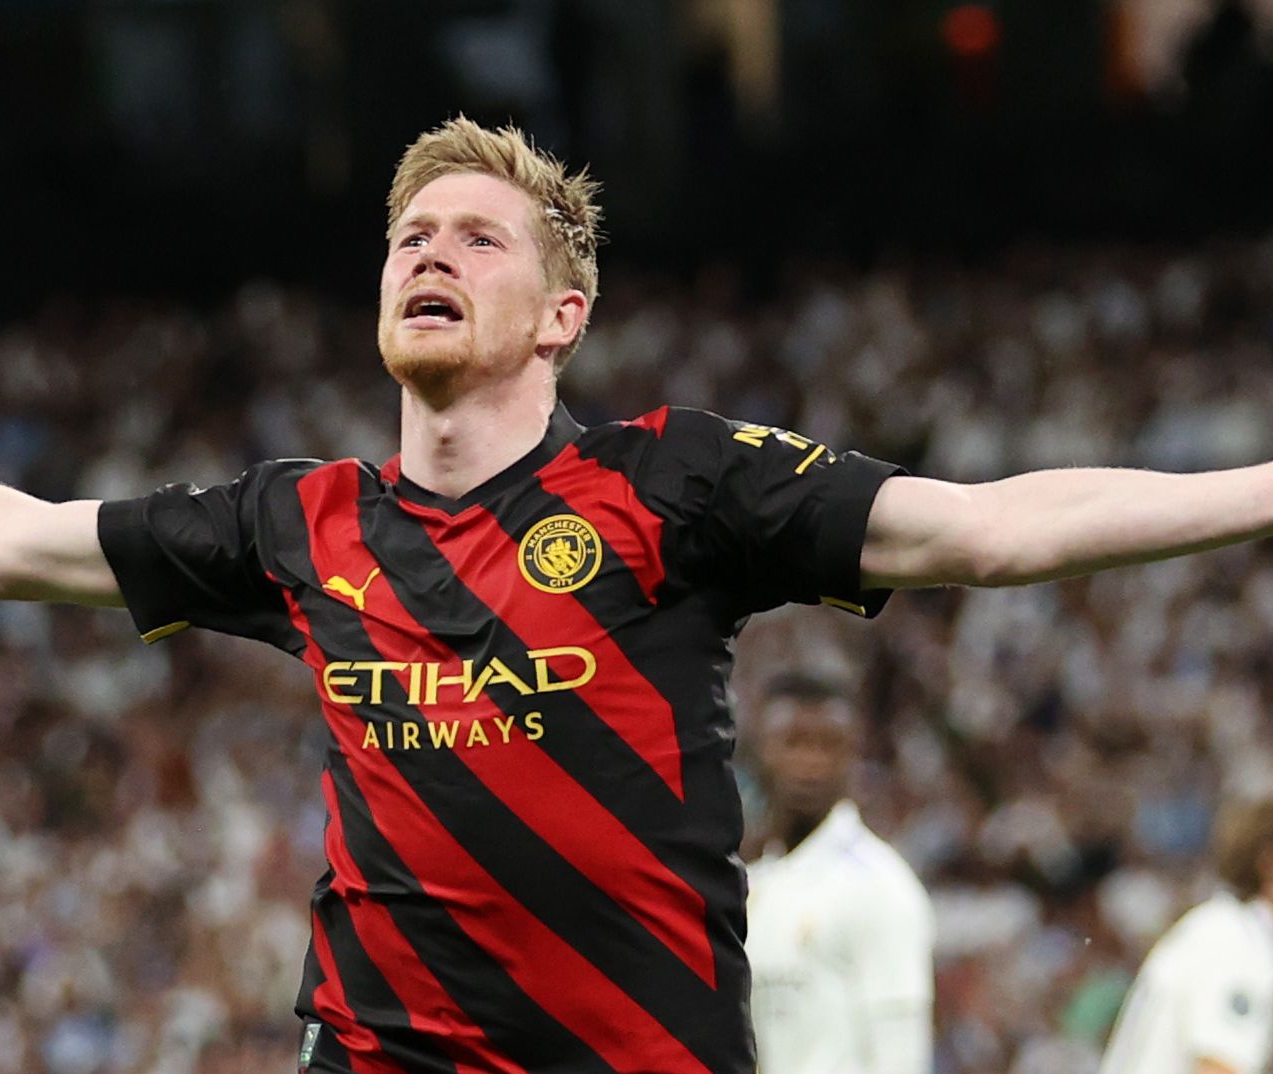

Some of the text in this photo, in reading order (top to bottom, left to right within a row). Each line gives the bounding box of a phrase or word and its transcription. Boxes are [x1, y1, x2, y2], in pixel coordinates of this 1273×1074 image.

[528, 520, 592, 548] MANCHESTER
[549, 577, 574, 587] CITY
[323, 646, 598, 705] ETIHAD
[362, 711, 545, 750] AIRWAYS
